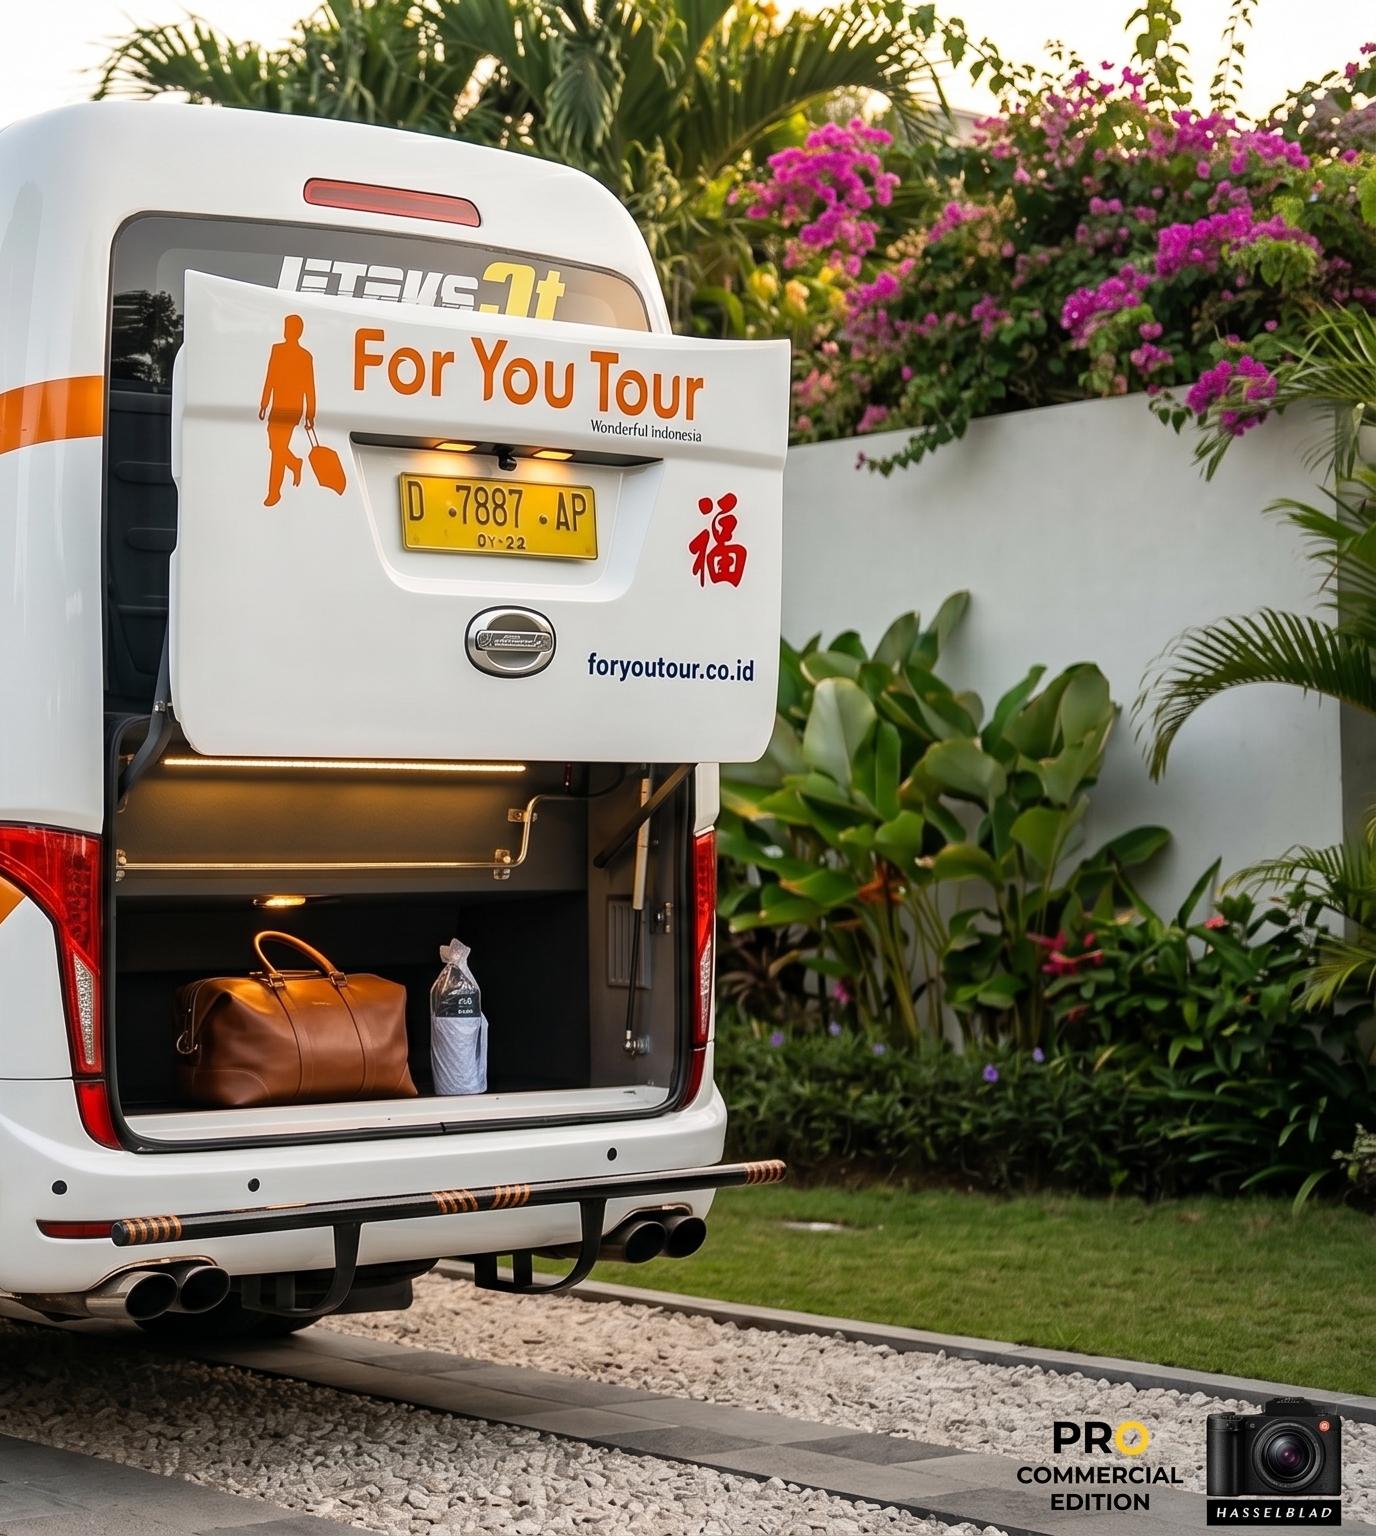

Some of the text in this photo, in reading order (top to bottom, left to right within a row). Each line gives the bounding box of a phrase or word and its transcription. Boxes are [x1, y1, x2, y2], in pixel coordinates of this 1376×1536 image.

[353, 327, 705, 421] For You Tour
[590, 419, 702, 442] Wonderful indonesia
[407, 480, 425, 522] D
[555, 491, 587, 532] AP
[688, 492, 748, 588] 福
[587, 652, 755, 682] foryoutour.co.id
